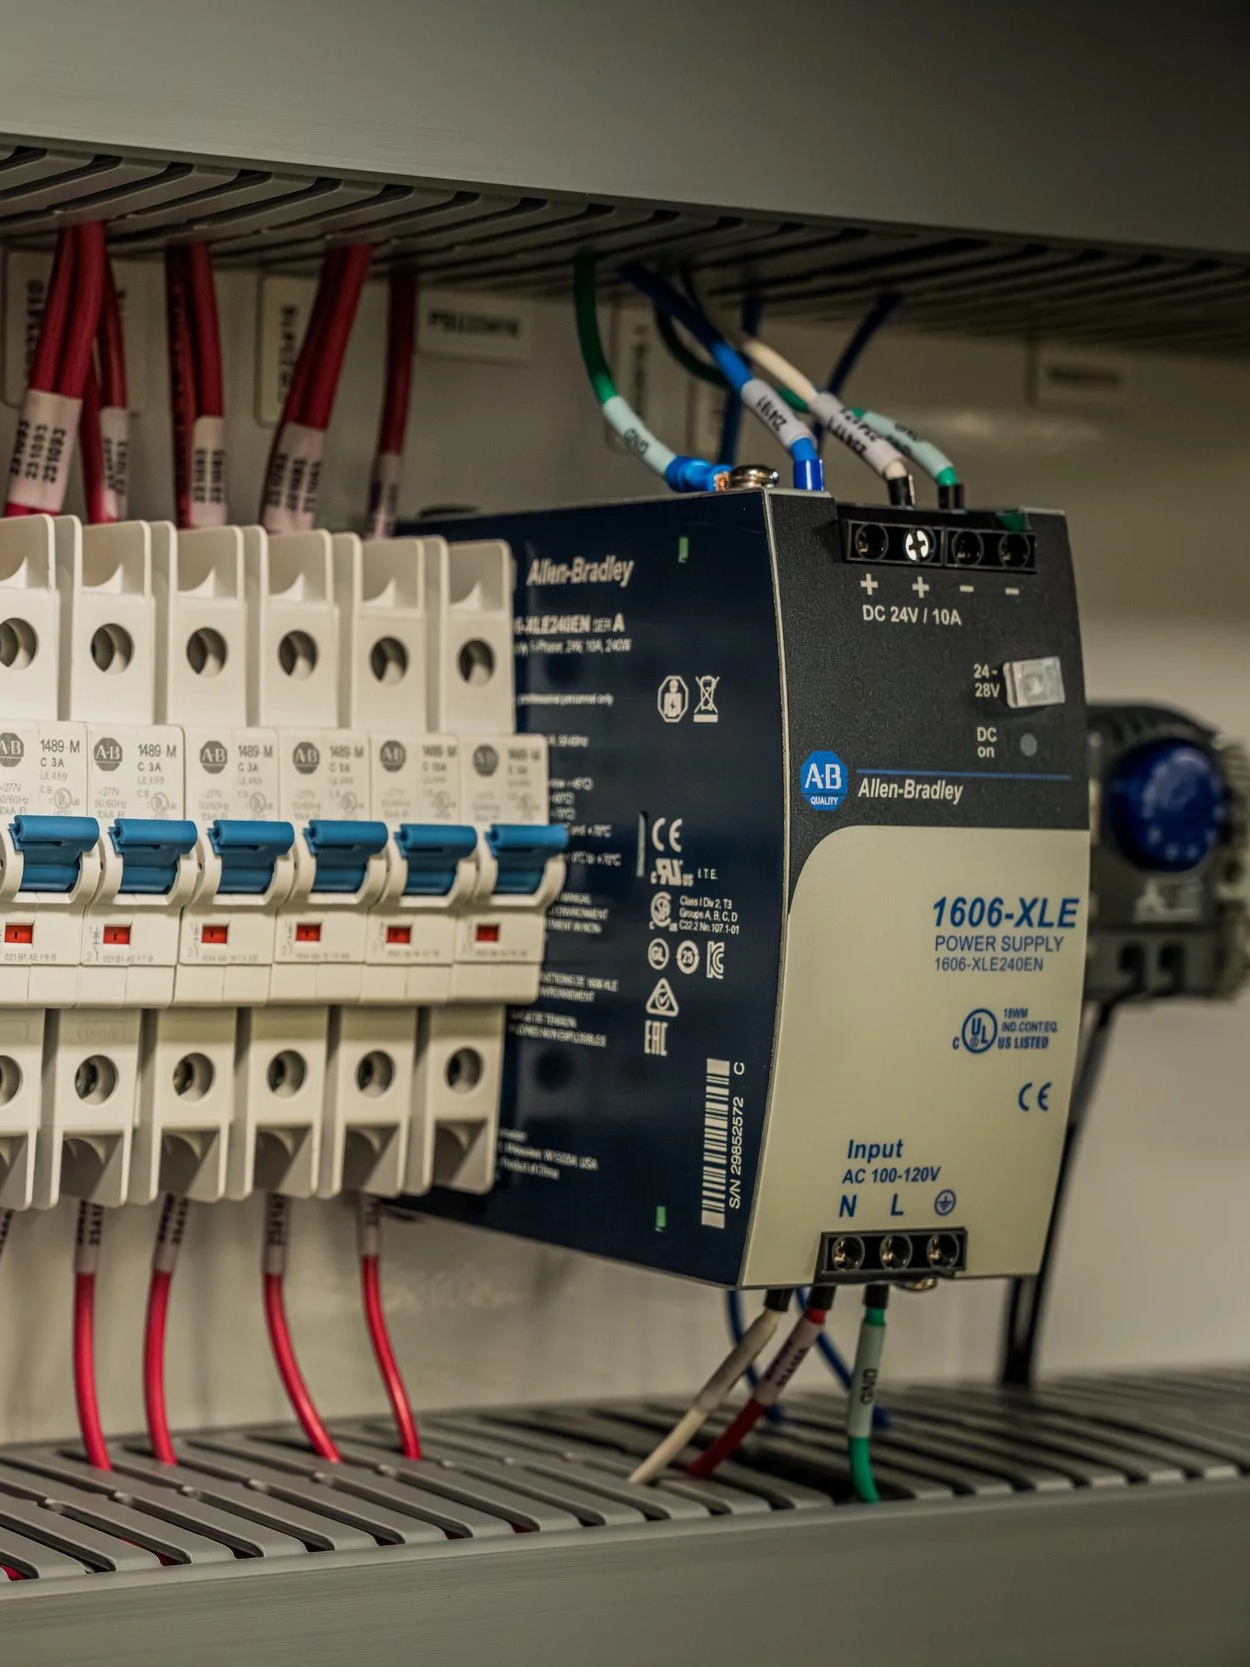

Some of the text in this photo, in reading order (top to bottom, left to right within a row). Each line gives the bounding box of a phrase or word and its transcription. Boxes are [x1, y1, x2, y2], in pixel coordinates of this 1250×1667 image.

[526, 555, 635, 588] Allen-Bradley
[612, 612, 625, 632] A
[862, 604, 963, 627] DC 24V / 10A
[974, 683, 1001, 699] 28V
[976, 726, 998, 743] DC
[976, 745, 996, 759] on
[810, 795, 838, 806] QUALITY
[857, 777, 964, 805] Allen-Bradley
[679, 895, 698, 907] Class
[722, 898, 733, 910] T3
[679, 907, 704, 920] Groups
[730, 912, 738, 922] D
[932, 896, 1080, 929] 1606-XLE
[934, 934, 1065, 953] POWER SUPPLY
[934, 955, 1044, 973] 1606-XLE240EN
[997, 1036, 1012, 1050] US
[1013, 1035, 1050, 1050] LISTED
[733, 1061, 746, 1076] C
[729, 1096, 744, 1210] S/N 29852572
[847, 1138, 904, 1164] Input
[842, 1166, 941, 1184] AC 100-120V
[838, 1194, 858, 1218] N
[890, 1193, 904, 1217] L
[860, 1367, 878, 1405] GND
